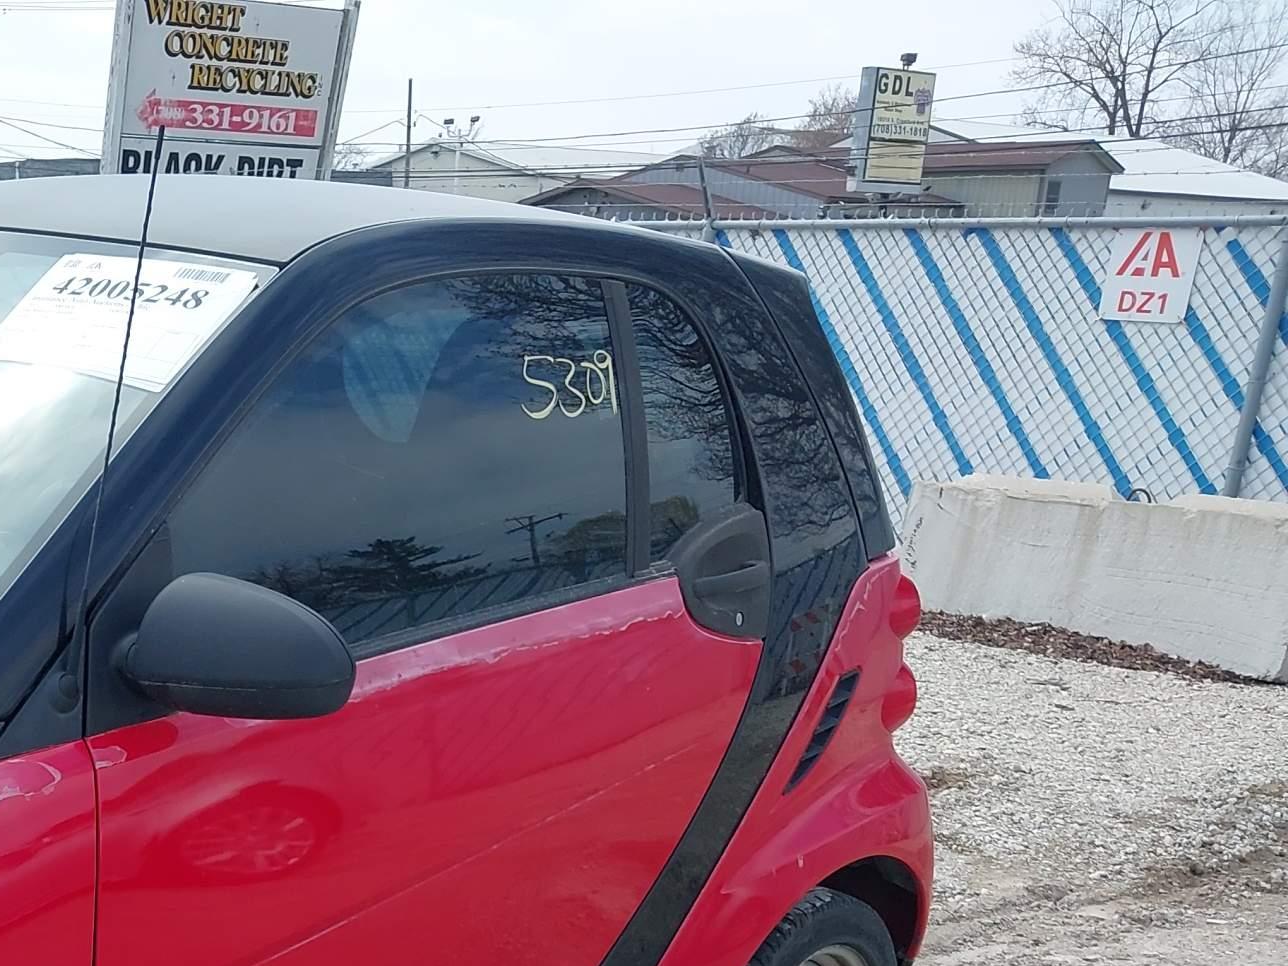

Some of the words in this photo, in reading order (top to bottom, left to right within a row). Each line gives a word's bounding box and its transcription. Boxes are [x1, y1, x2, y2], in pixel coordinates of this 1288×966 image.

[145, 0, 247, 32] WRIGHT
[165, 30, 290, 67] CONCRETE
[188, 64, 318, 99] RECYCLING
[878, 73, 913, 97] GDL
[186, 104, 297, 135] 331-9161
[52, 276, 210, 310] 42005248
[1117, 290, 1169, 315] DZ1
[520, 349, 617, 419] 5309
